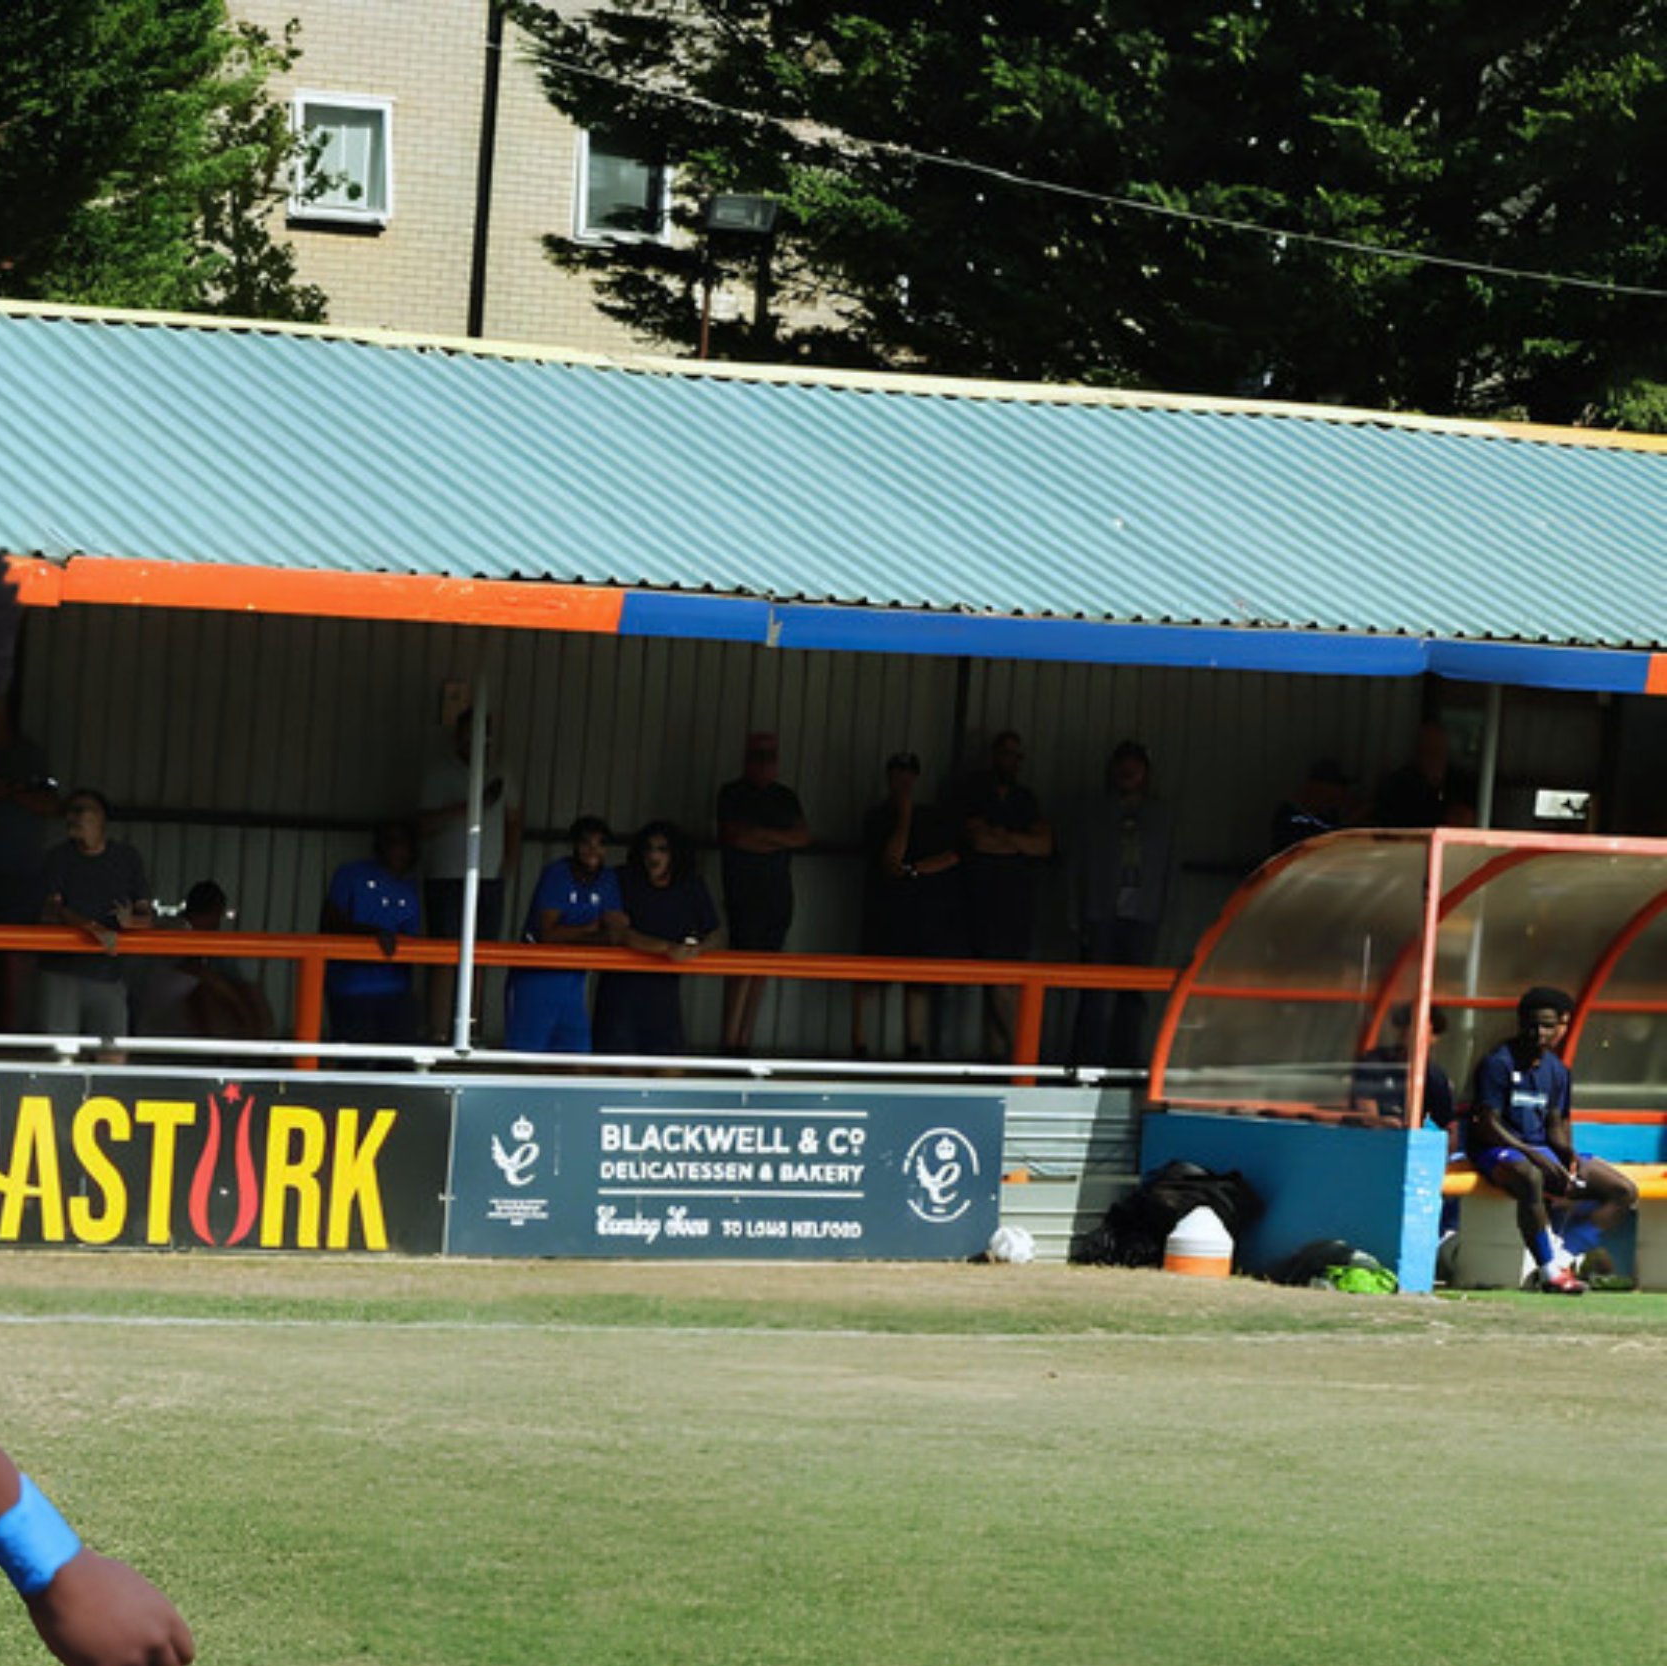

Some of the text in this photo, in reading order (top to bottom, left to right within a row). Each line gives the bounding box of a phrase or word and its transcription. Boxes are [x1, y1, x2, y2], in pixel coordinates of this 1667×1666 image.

[601, 1124, 790, 1153] BLACKWELL
[798, 1126, 819, 1154] &
[600, 1161, 865, 1183] DELICATESSEN & BAKERY
